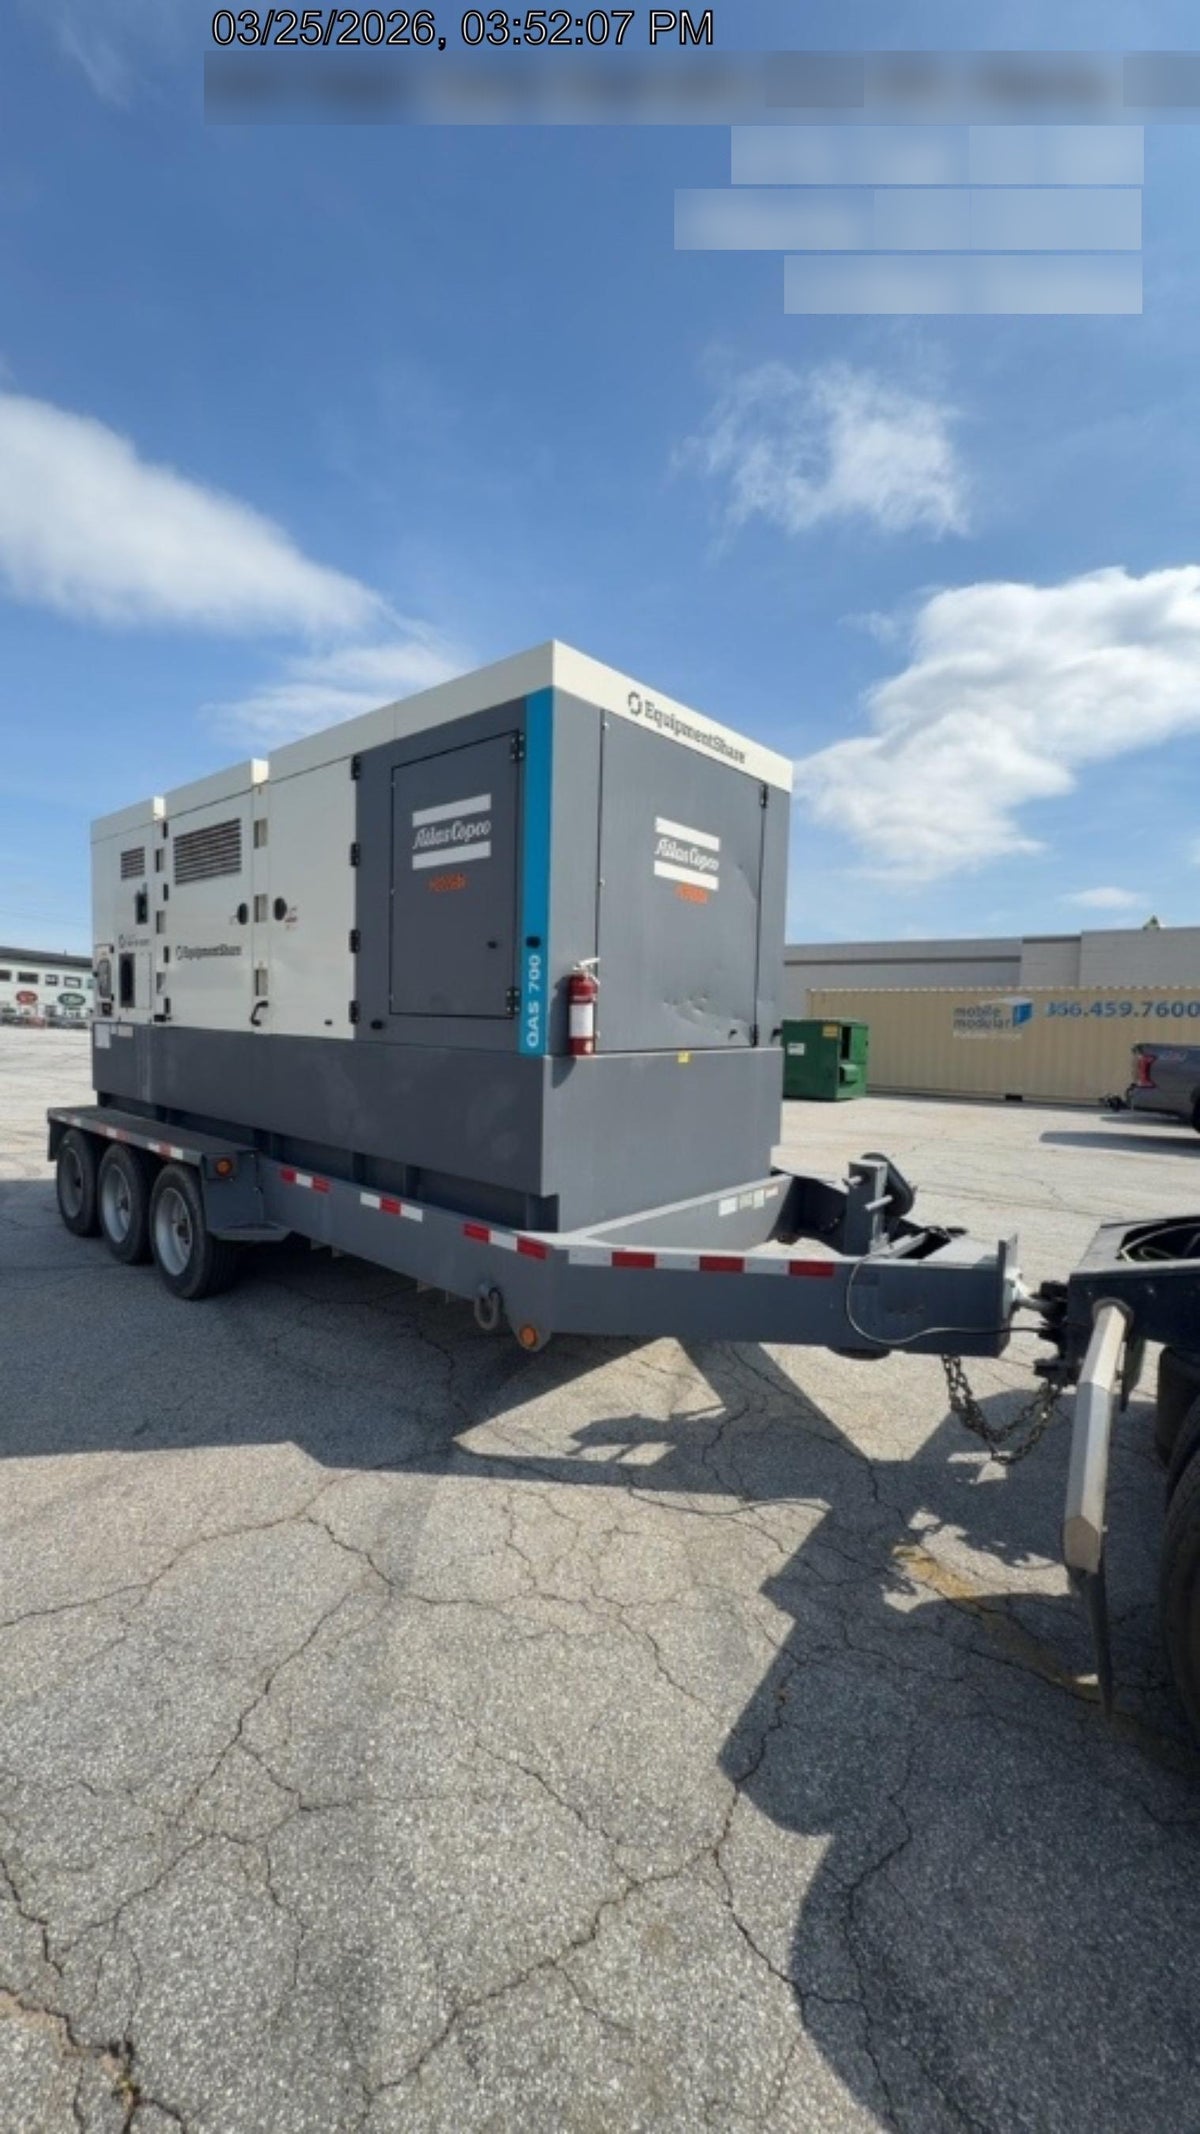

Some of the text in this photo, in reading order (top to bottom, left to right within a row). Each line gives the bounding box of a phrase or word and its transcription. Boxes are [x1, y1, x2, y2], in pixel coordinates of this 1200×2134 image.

[645, 699, 745, 764] EquipmentShare
[526, 954, 541, 1049] QAS 700
